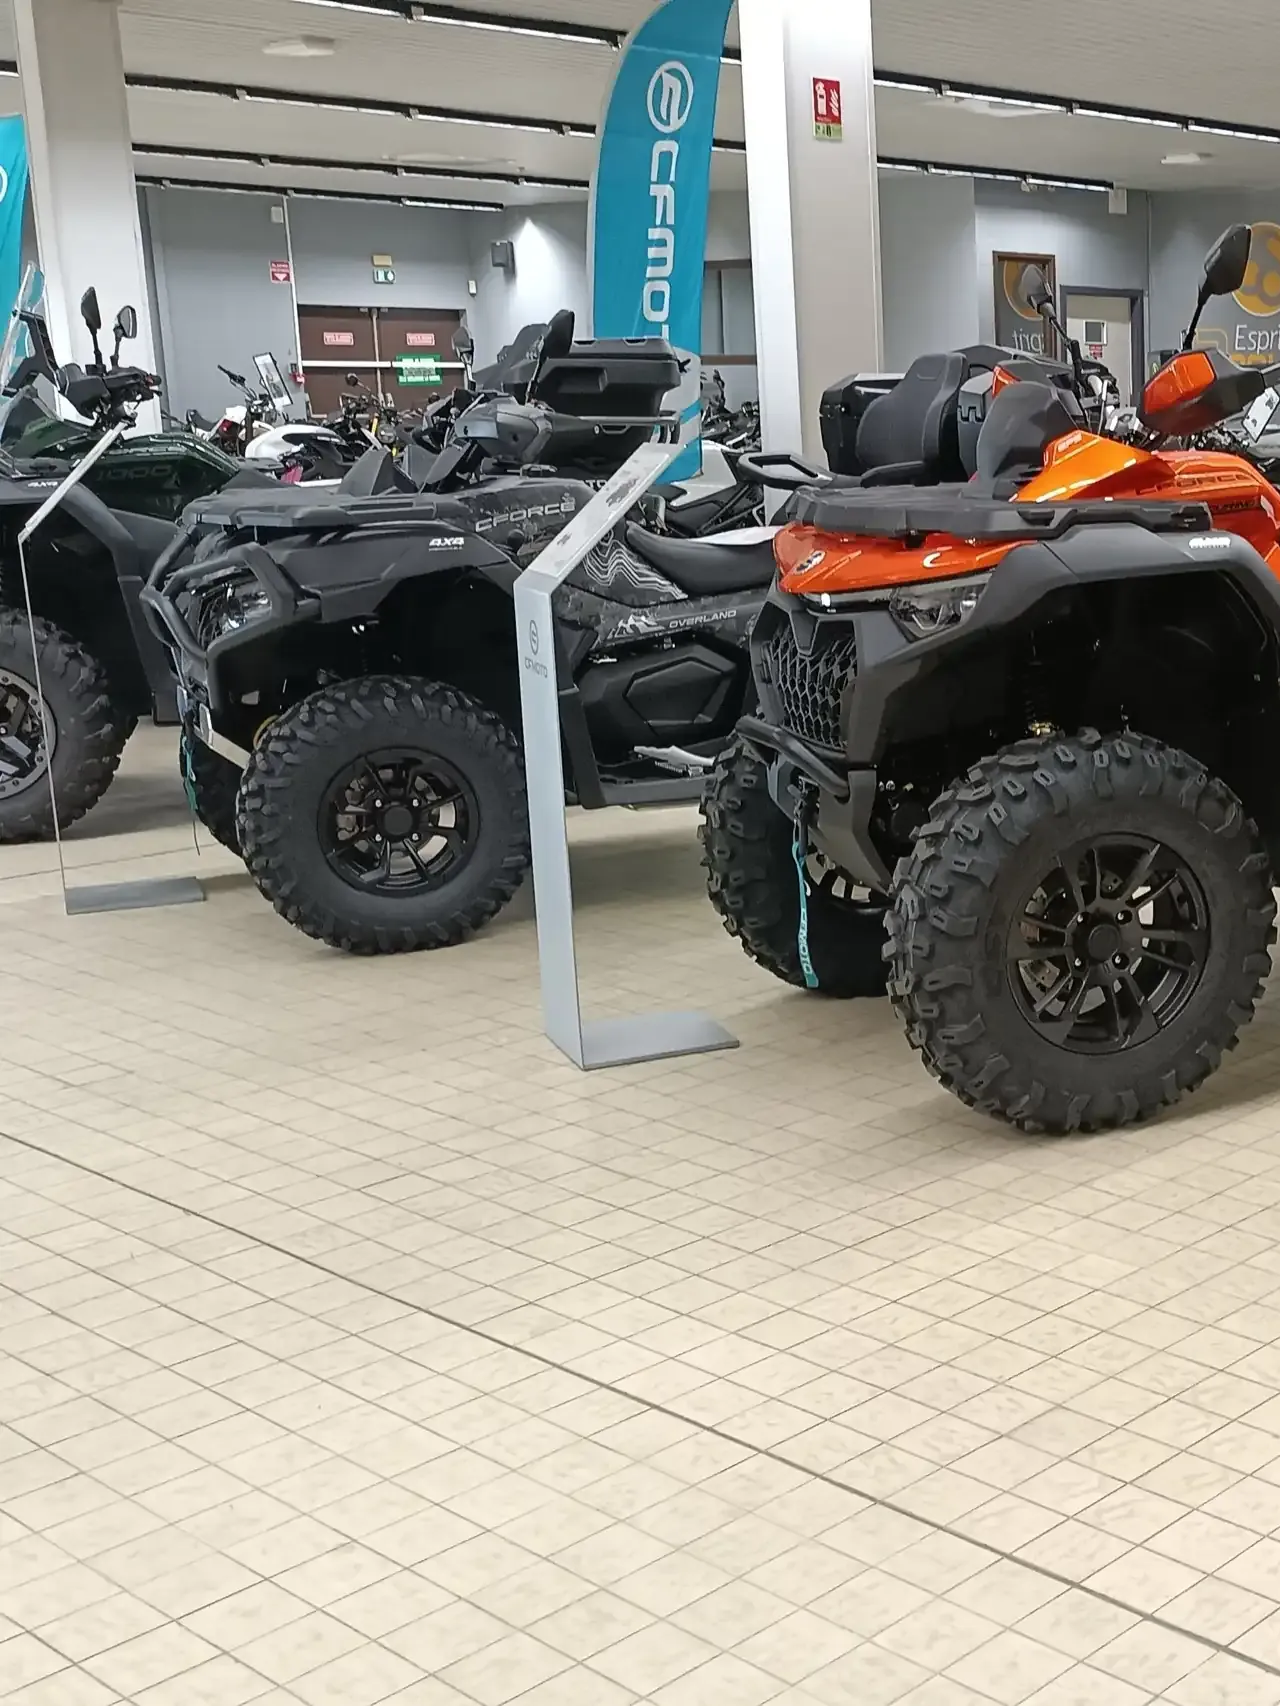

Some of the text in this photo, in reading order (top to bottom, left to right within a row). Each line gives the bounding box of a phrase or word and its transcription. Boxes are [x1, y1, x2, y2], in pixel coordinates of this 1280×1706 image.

[642, 139, 680, 339] CFMO
[475, 498, 576, 532] CFORCE
[669, 609, 737, 628] OVERLAND
[524, 656, 548, 679] CFMOTO
